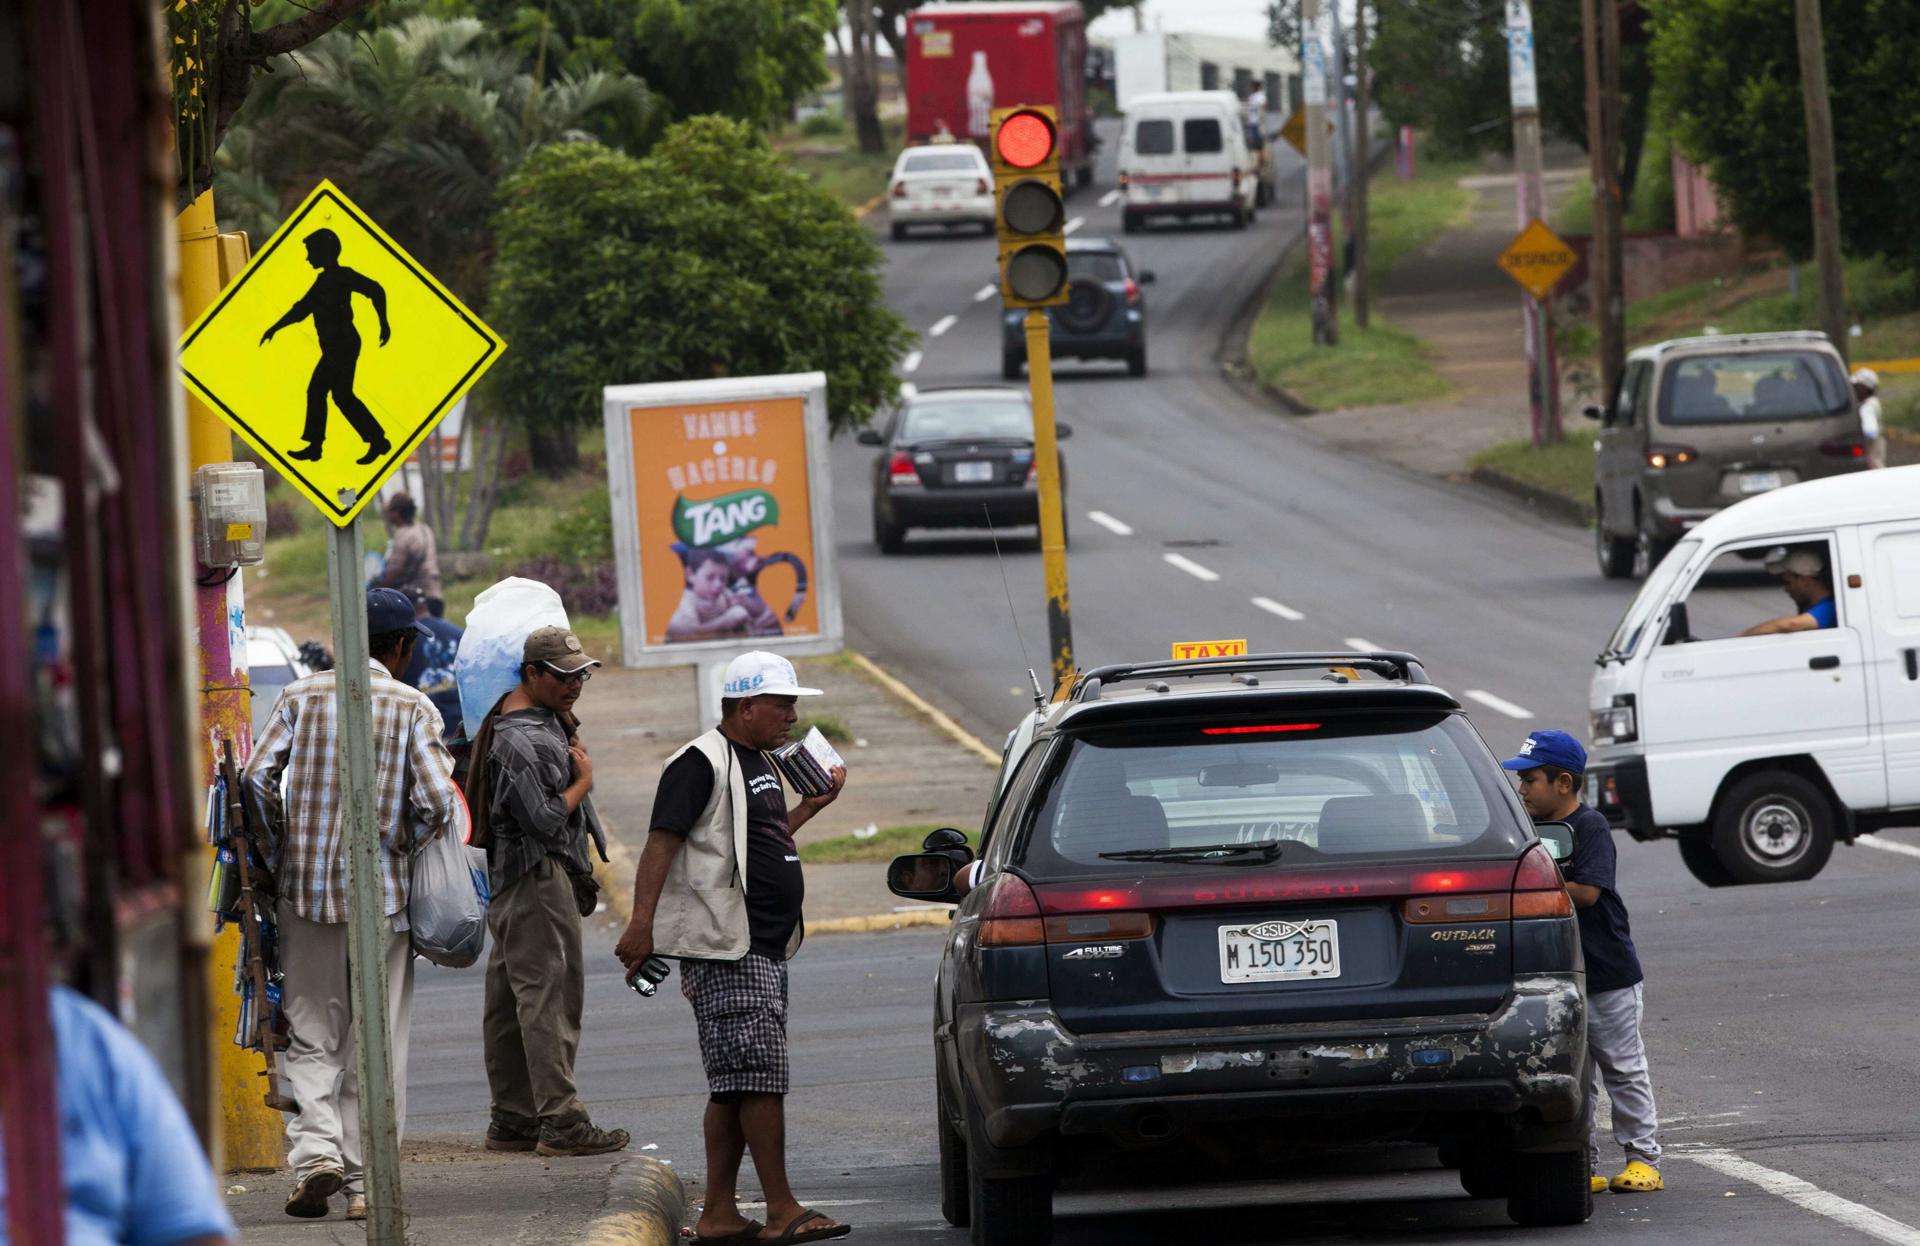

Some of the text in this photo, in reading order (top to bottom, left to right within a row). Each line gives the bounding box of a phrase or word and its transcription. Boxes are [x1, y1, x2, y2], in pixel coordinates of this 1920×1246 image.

[684, 411, 756, 440] VAMOS
[666, 456, 777, 491] HACERLO
[684, 496, 766, 545] TANG
[1181, 643, 1239, 659] TAXI
[1256, 924, 1292, 937] JESUS
[1430, 928, 1496, 941] OUTBACK
[1227, 940, 1332, 969] M 150 350
